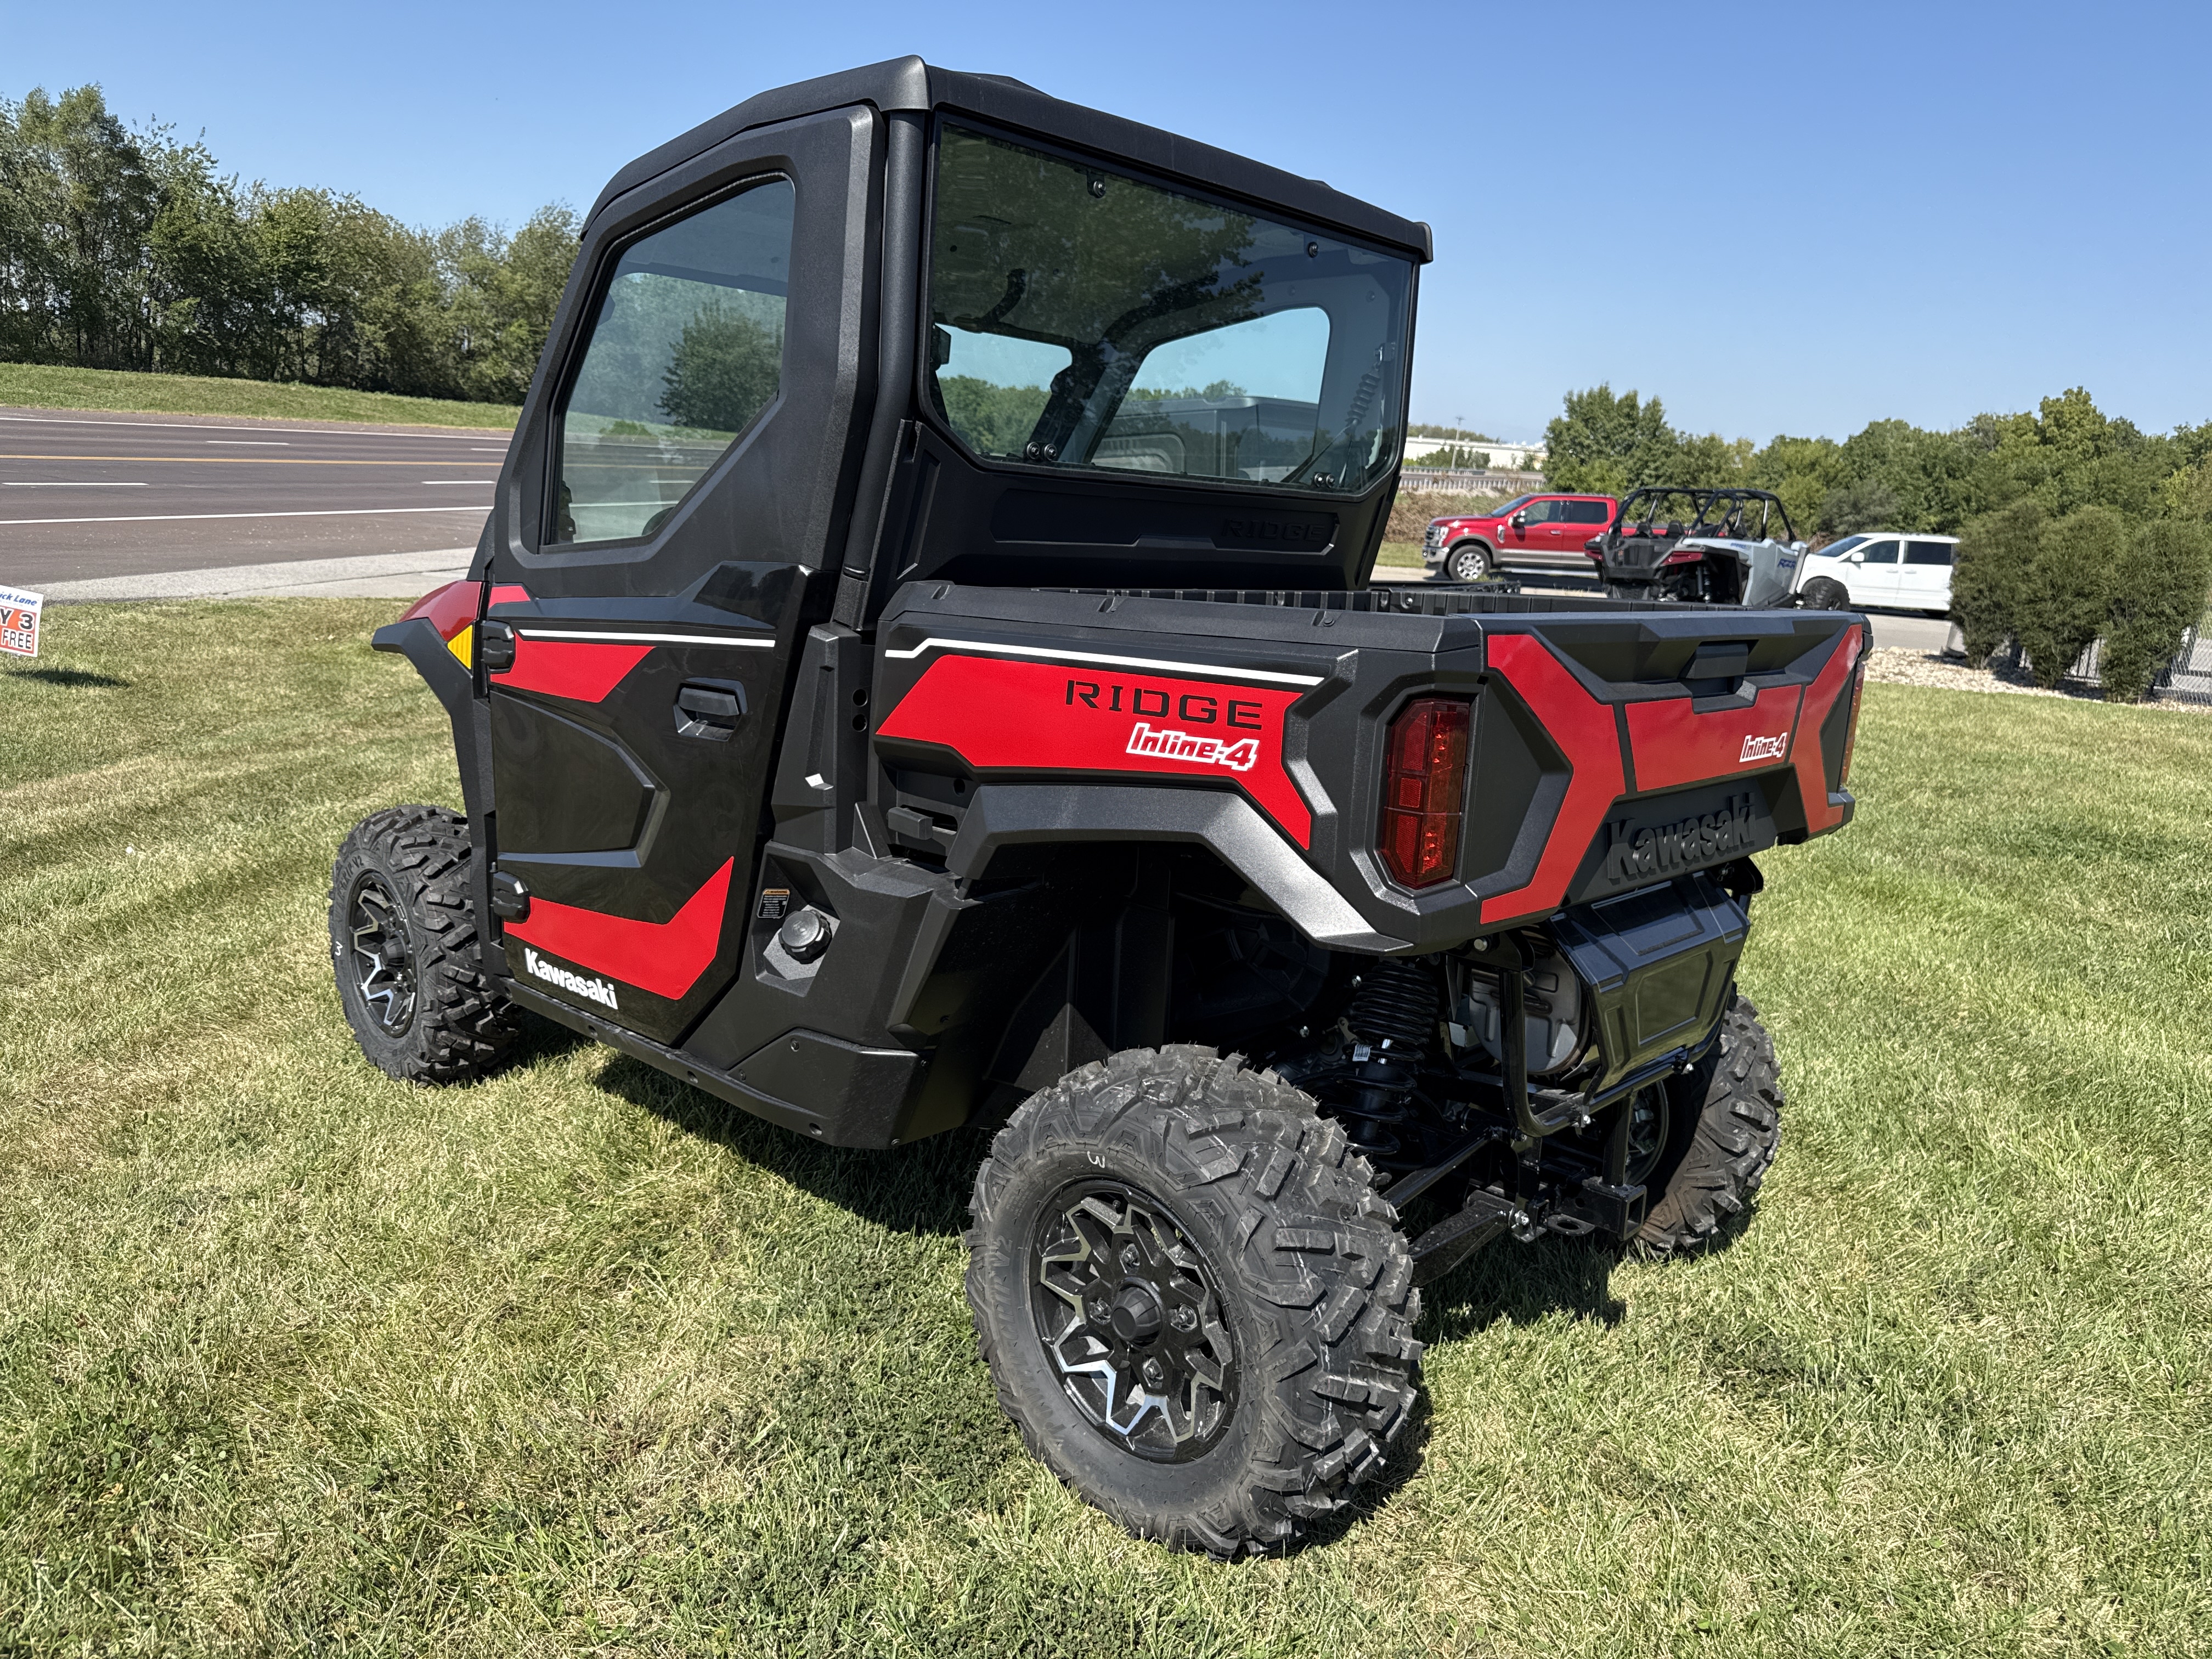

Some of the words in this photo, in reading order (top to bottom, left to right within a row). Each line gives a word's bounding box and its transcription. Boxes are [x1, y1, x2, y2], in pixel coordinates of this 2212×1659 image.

[1222, 518, 1325, 541] RIDGE
[13, 595, 38, 606] Lane
[0, 608, 12, 625] Y
[20, 613, 33, 630] 3
[3, 629, 32, 650] FREE
[1065, 679, 1263, 730] RIDGE
[1125, 722, 1260, 771] Inline-4
[1739, 732, 1787, 763] Inline-4
[1607, 792, 1756, 879] Kawasaki
[524, 947, 618, 1009] Kawasaki
